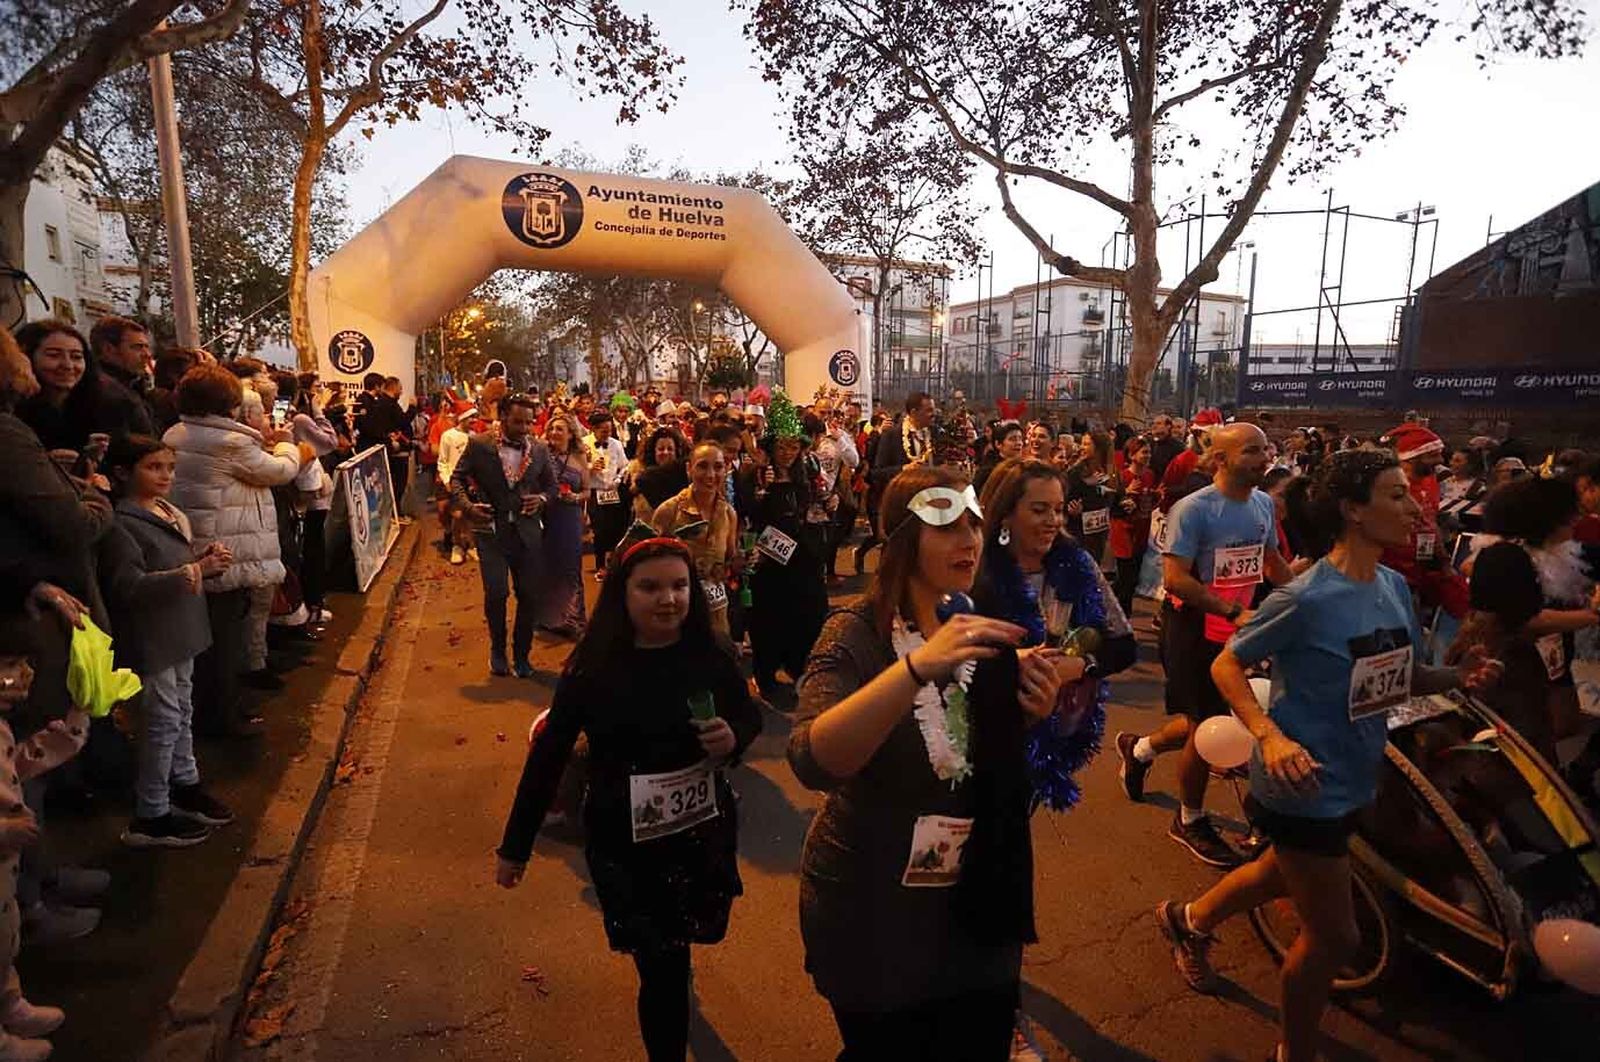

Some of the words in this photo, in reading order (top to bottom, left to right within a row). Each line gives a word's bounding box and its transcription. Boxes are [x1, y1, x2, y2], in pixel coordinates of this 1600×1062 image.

[587, 185, 724, 209] Ayuntamiento
[628, 205, 652, 220] de
[659, 207, 725, 227] Huelva
[659, 226, 674, 237] de
[676, 228, 726, 241] Deportes
[1266, 382, 1308, 391] HYUNDAI
[1336, 380, 1386, 390] HYUNDAI
[1436, 377, 1497, 388] HYUNDAI
[772, 538, 791, 556] 146
[1236, 556, 1259, 575] 373
[1376, 667, 1406, 696] 374
[670, 780, 709, 815] 329
